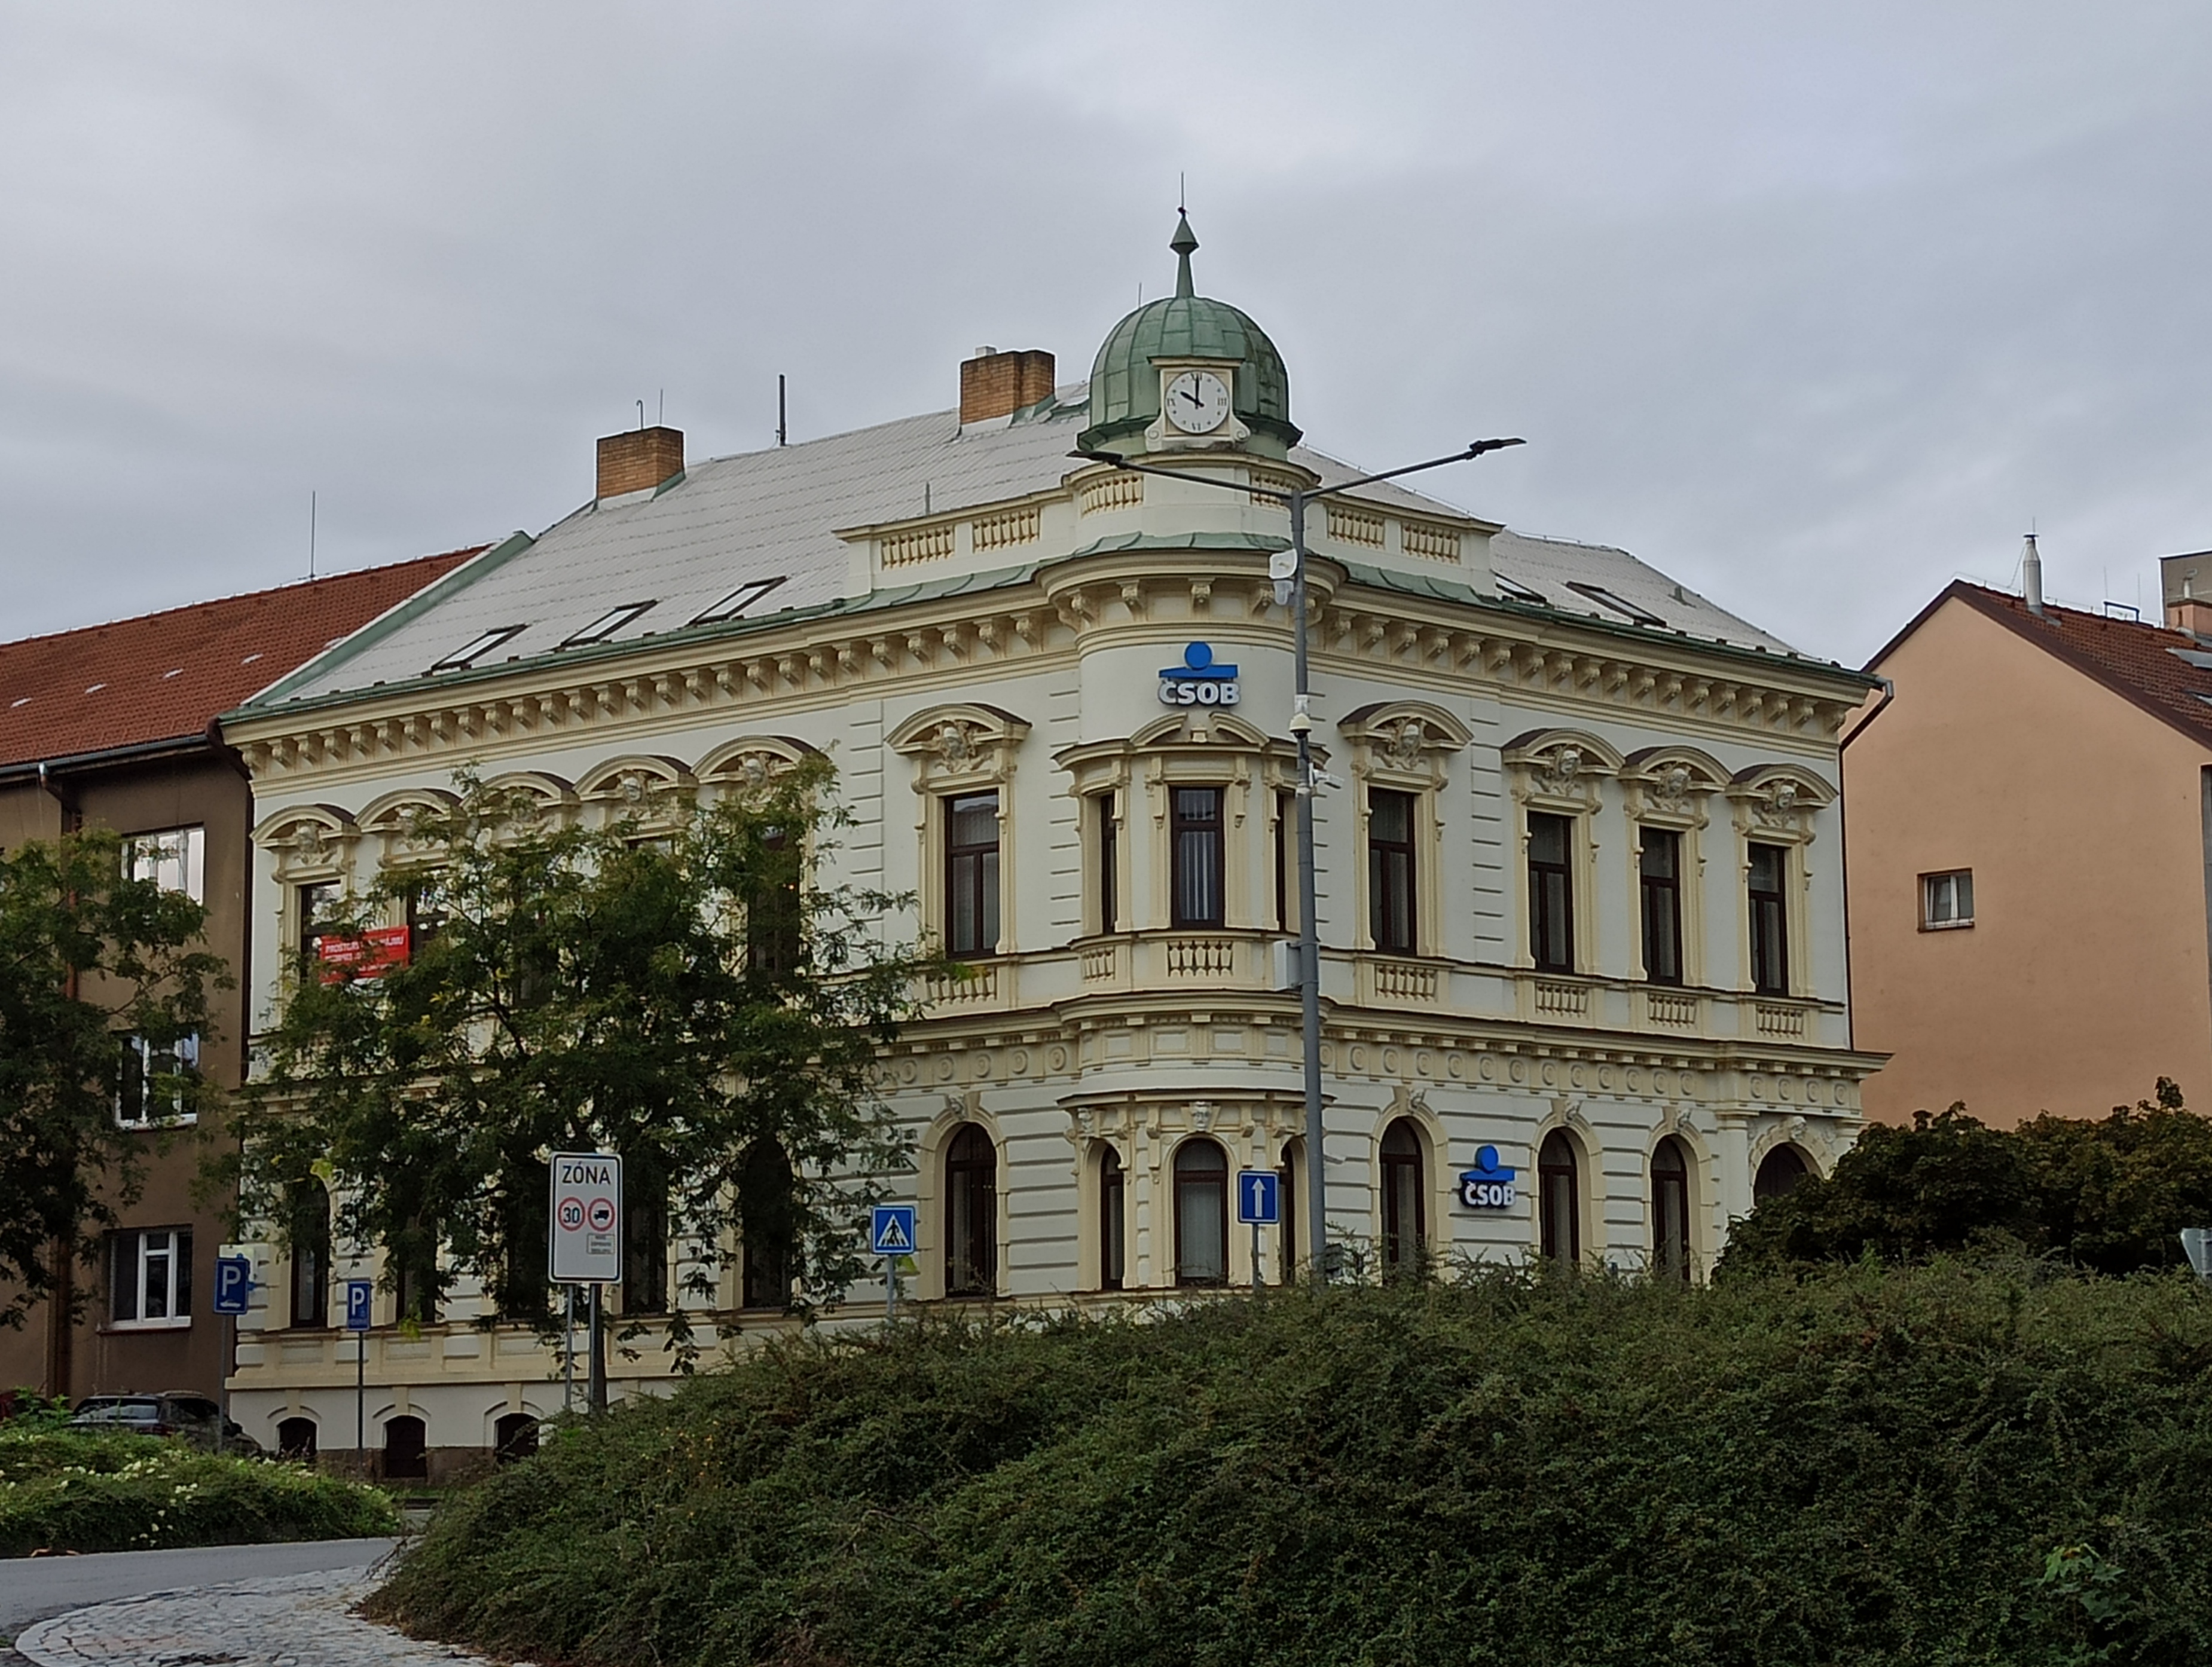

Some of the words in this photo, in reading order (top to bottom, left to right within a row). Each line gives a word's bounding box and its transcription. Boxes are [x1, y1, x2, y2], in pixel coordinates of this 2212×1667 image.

[1158, 680, 1241, 705] ČSOB
[562, 1161, 611, 1185] ZÓNA
[1465, 1181, 1516, 1206] ČSOB
[563, 1207, 581, 1224] 30
[222, 1265, 242, 1297] P
[352, 1287, 365, 1316] P
